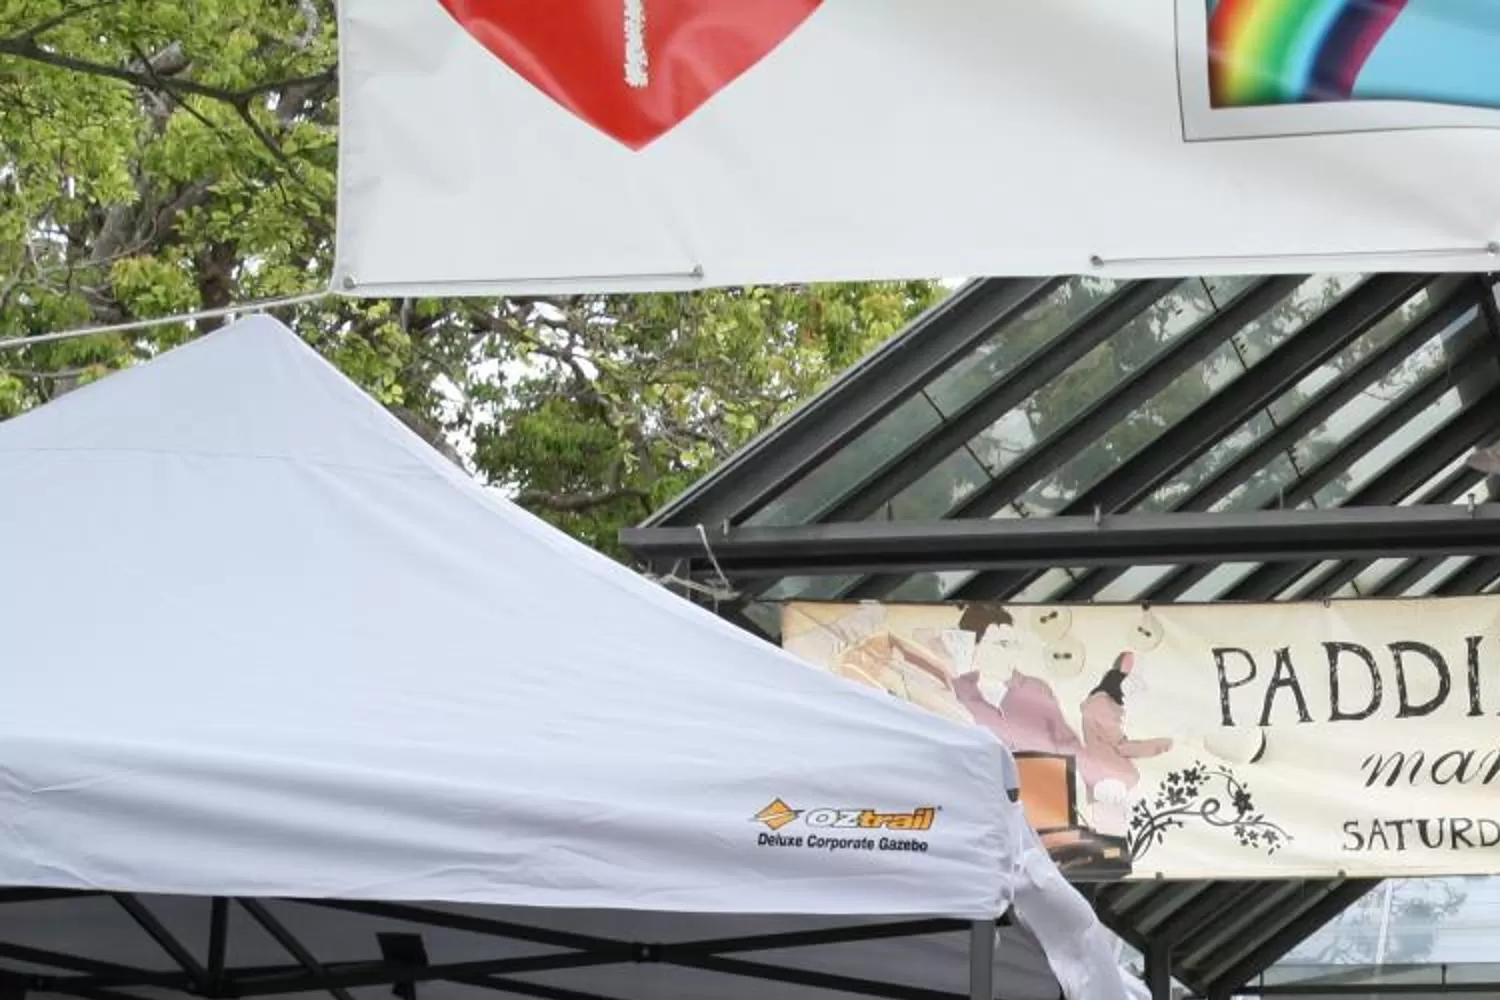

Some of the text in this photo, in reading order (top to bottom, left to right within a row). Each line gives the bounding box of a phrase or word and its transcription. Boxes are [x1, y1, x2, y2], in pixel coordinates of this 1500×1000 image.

[757, 832, 929, 852] Deluxe Corporate Gazebo
